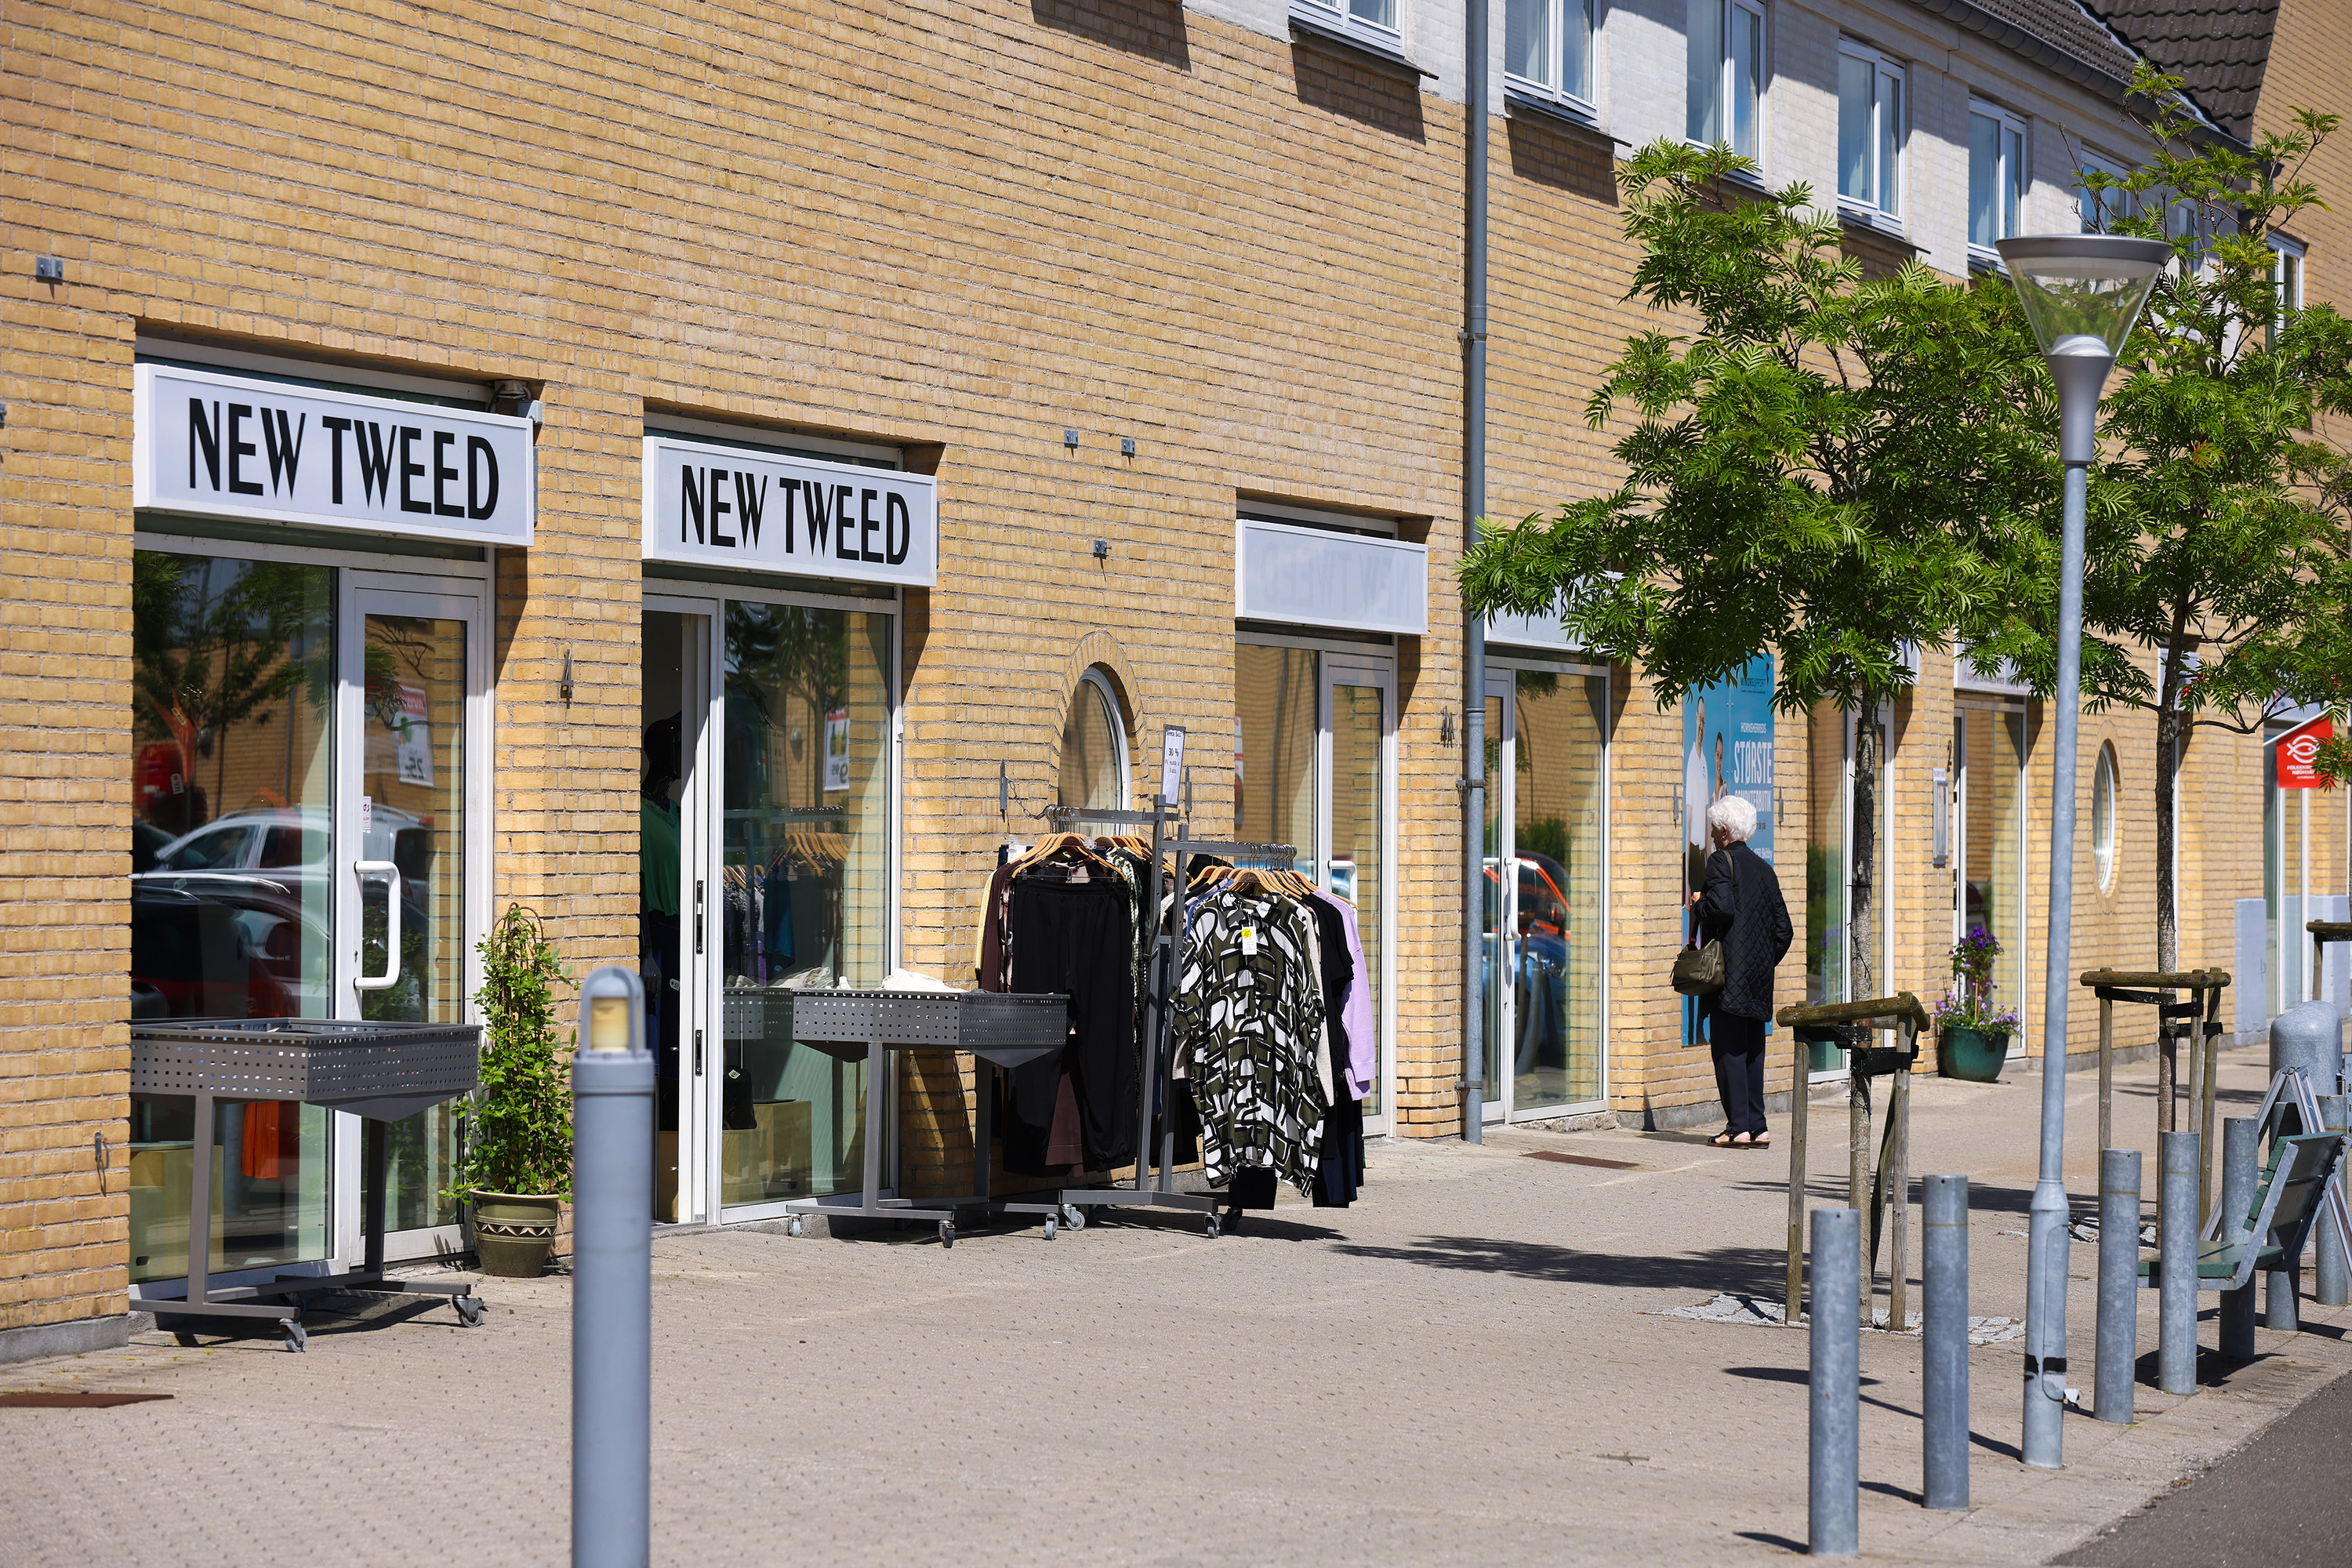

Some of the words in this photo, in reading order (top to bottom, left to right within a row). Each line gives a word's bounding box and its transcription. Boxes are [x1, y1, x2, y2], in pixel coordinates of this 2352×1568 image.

[189, 397, 306, 499] NEW
[322, 416, 499, 520] TWEED
[681, 464, 768, 550] NEW
[779, 477, 910, 565] TWEED
[1733, 740, 1772, 785] STØRSTE
